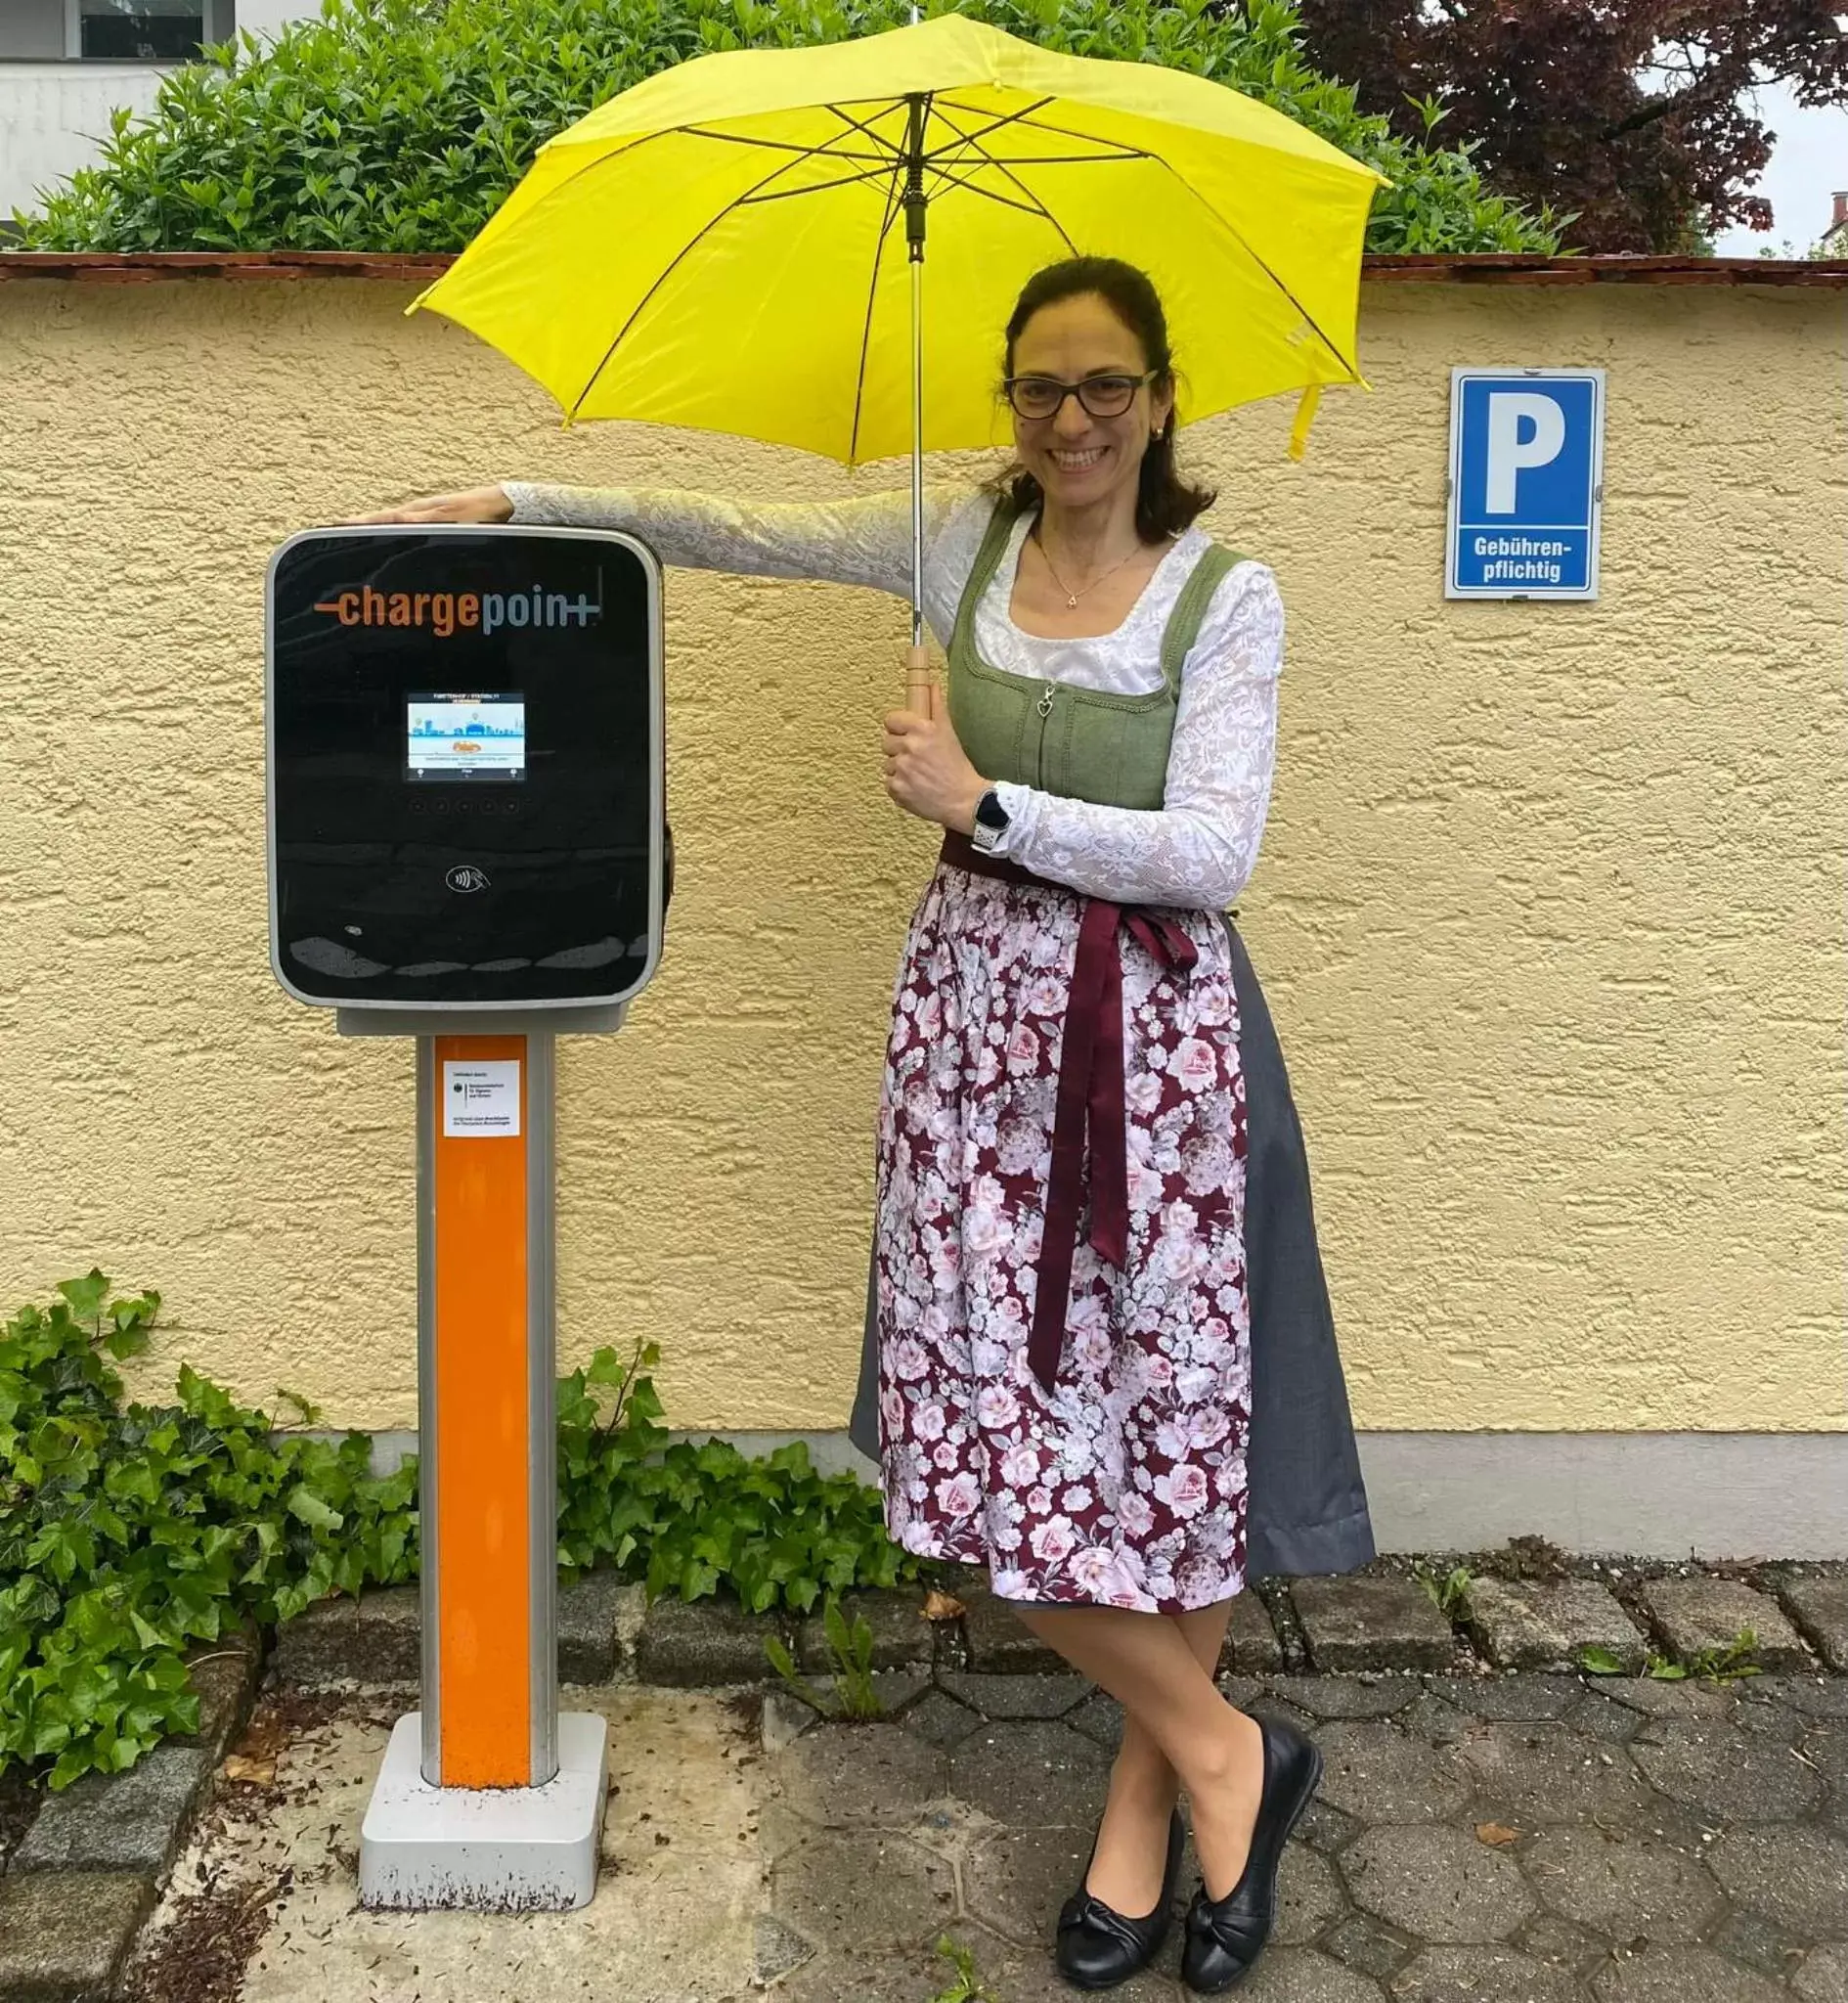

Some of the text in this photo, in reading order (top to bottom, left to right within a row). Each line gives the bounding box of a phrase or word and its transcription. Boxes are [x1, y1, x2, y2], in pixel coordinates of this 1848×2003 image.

[1486, 391, 1566, 513] P
[1474, 536, 1572, 556] Gebühren-
[1483, 560, 1562, 583] pflichtig
[314, 584, 600, 637] chargepoint
